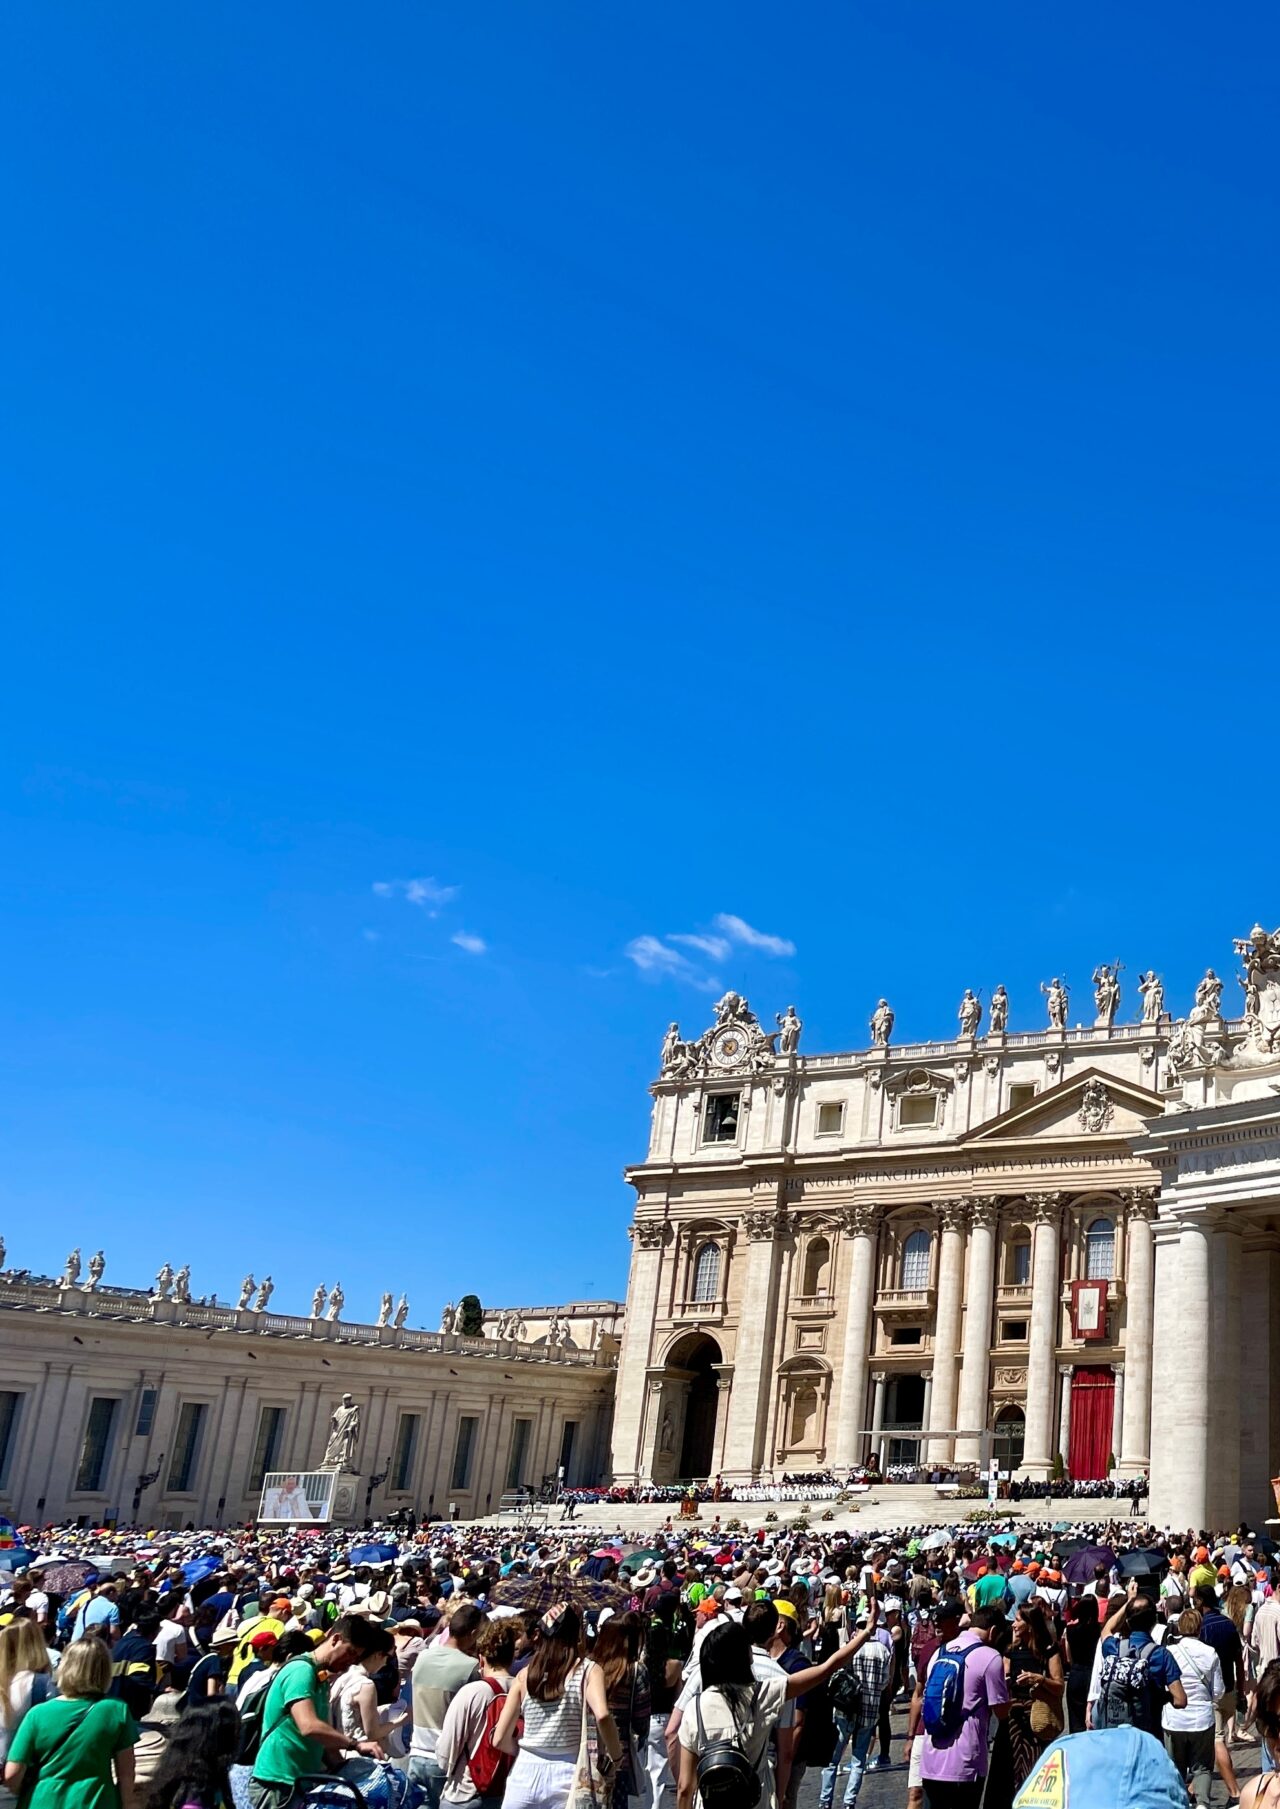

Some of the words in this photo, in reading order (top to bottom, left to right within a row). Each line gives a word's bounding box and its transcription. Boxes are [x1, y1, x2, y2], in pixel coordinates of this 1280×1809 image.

[757, 1177, 774, 1190] IN
[785, 1174, 856, 1190] HONOREM
[856, 1167, 929, 1184] PRINCIPIS
[931, 1163, 974, 1179] APOST
[974, 1159, 1024, 1174] PAVLVS
[1026, 1159, 1034, 1171] V
[1040, 1153, 1134, 1169] BVRGHESIVS
